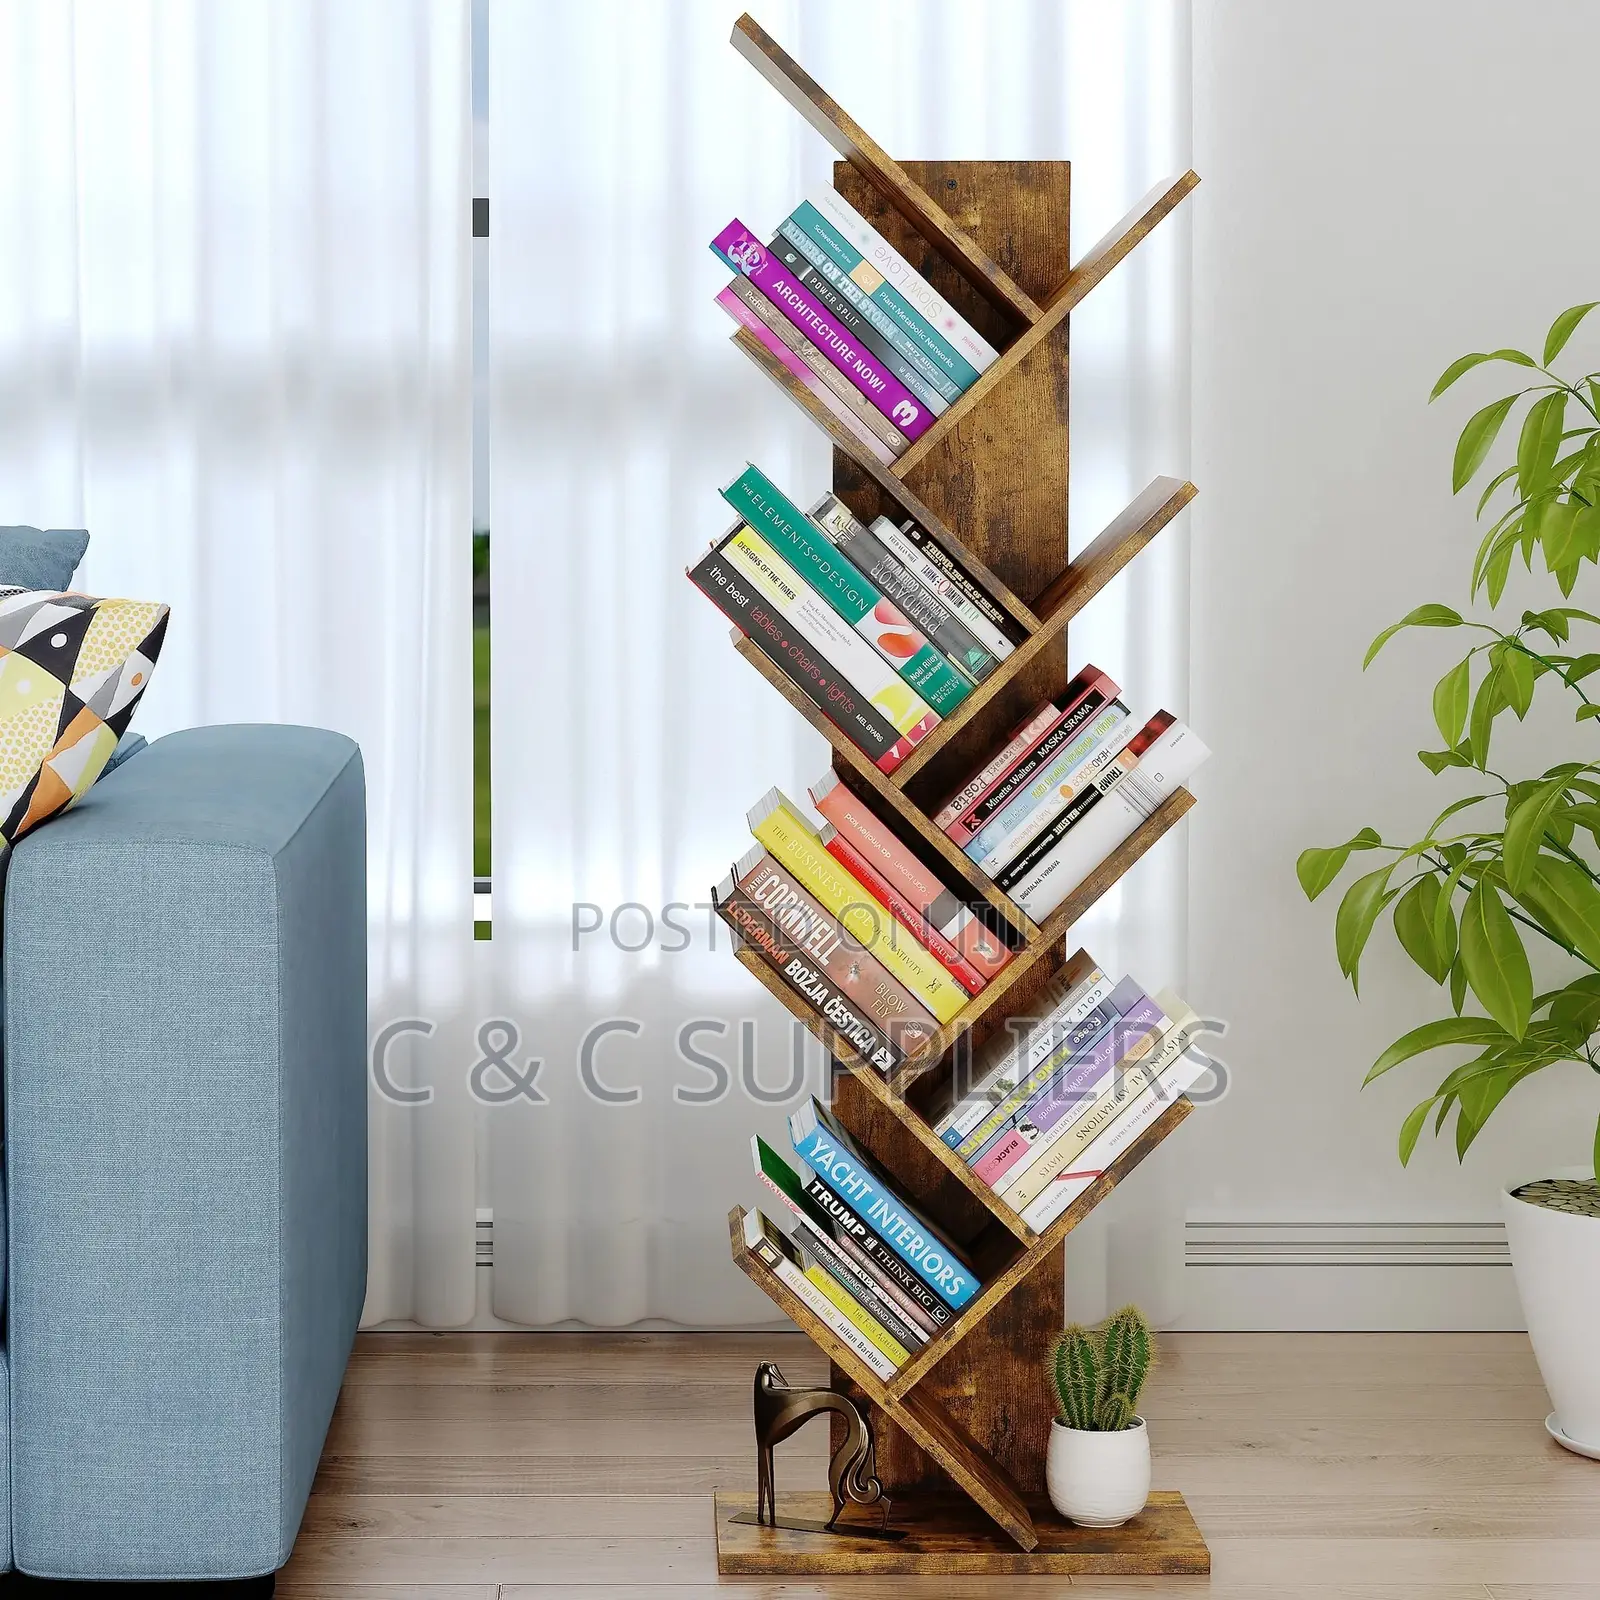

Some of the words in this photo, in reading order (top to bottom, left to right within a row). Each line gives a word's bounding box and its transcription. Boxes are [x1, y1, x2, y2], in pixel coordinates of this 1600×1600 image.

[812, 223, 843, 254] Schwender
[780, 221, 826, 267] RIDERS
[819, 259, 842, 282] ON
[834, 275, 863, 303] THE
[856, 296, 899, 339] STORM
[868, 243, 911, 286] Love
[743, 289, 773, 318] Perfume
[808, 276, 837, 305] POWER
[834, 302, 860, 327] SPLIT
[901, 276, 945, 319] Slow
[770, 277, 858, 363] ARCHITECTURE
[851, 358, 887, 394] NOW!
[878, 290, 898, 310] Plant
[893, 307, 927, 340] Metabolic
[923, 337, 956, 369] Networks
[801, 347, 827, 372] Patrick
[739, 482, 755, 497] THE
[749, 492, 815, 557] ELEMENTS
[817, 560, 870, 612] DESIGN
[735, 540, 763, 567] DESIGNS
[759, 563, 771, 575] OF
[766, 570, 779, 584] THE
[774, 579, 797, 601] TIMES
[879, 552, 921, 593] CORNWELL
[866, 559, 944, 636] PREDATOR
[919, 563, 939, 583] TAKING
[933, 576, 968, 611] QUANTUM
[950, 568, 964, 582] THE
[960, 579, 974, 593] ART
[970, 589, 982, 601] OF
[978, 597, 993, 611] THE
[989, 607, 1006, 624] DEAL
[914, 587, 951, 623] PATRICIA
[707, 564, 730, 587] the
[723, 580, 752, 608] best
[747, 602, 787, 642] tables
[785, 641, 825, 681] chairs
[821, 679, 860, 718] lights
[853, 712, 868, 727] MEL
[864, 723, 885, 743] BYARS
[921, 651, 939, 670] Riley
[915, 669, 933, 687] Patricia
[930, 673, 957, 701] MITCHELL
[935, 678, 961, 704] BEAZLEY
[983, 780, 1014, 811] Minette
[1007, 757, 1038, 787] Walters
[1035, 727, 1067, 759] MASKA
[1061, 700, 1094, 733] SRAMA
[1068, 745, 1112, 788] HEADspace
[948, 774, 989, 814] Pošta
[1095, 764, 1124, 793] TRUMP
[842, 810, 860, 828] kod
[1051, 816, 1071, 836] ESTATE
[1065, 807, 1080, 822] REAL
[854, 822, 884, 851] vincijev
[878, 846, 892, 860] da
[744, 865, 772, 893] PATRICIA
[890, 858, 915, 882] brown
[910, 877, 927, 894] dan
[770, 824, 789, 843] THE
[784, 838, 846, 899] BUSINESS
[840, 893, 875, 927] SDE
[869, 923, 883, 937] OF
[880, 934, 924, 977] CREATIVITY
[1018, 876, 1043, 900] DIGITALNA
[750, 871, 849, 968] CORNWELL
[885, 894, 901, 911] THE
[898, 907, 922, 931] FABRIC
[918, 927, 931, 940] OF
[927, 936, 955, 963] REALITY
[723, 898, 791, 966] LEDERMAN
[782, 954, 834, 1006] BOŽJA
[820, 992, 883, 1055] ČESTICA
[869, 997, 893, 1021] FLY
[873, 981, 908, 1016] BLOW
[1074, 988, 1103, 1016] GOLF
[1058, 1016, 1075, 1032] AT
[1071, 1015, 1103, 1046] Reese
[1128, 1007, 1153, 1032] Wicked
[1031, 1032, 1058, 1059] YALE
[1110, 1027, 1133, 1049] Words
[1034, 1045, 1073, 1083] HONG
[1081, 1062, 1097, 1078] Best
[1092, 1051, 1108, 1067] The
[1129, 1028, 1189, 1088] EXISTENTIAL
[1054, 1080, 1079, 1104] Wicked
[1073, 1073, 1085, 1085] of
[1001, 1078, 1039, 1116] KONG
[1036, 1099, 1059, 1121] Words
[1070, 1090, 1096, 1116] INVISIBLE
[1042, 1113, 1074, 1144] CAPITALISM
[1074, 1084, 1132, 1142] ASPIRATIONS
[958, 1110, 1006, 1158] NIGHTS
[994, 1138, 1019, 1163] BLACK
[1037, 1151, 1064, 1178] HAYES
[804, 1135, 874, 1205] YACHT
[865, 1196, 968, 1298] INTERIORS
[806, 1179, 868, 1240] TRUMP
[873, 1246, 915, 1288] THINK
[909, 1282, 935, 1307] BIG
[811, 1240, 837, 1266] STEPHEN
[833, 1262, 862, 1291] HAWKING
[857, 1289, 872, 1304] THE
[867, 1299, 890, 1322] GRAND
[885, 1317, 908, 1340] DESIGN
[812, 1226, 856, 1269] MASTER
[855, 1268, 878, 1290] KEY
[876, 1289, 920, 1332] SYSTEM
[784, 1270, 801, 1286] THE
[796, 1281, 813, 1298] END
[808, 1294, 822, 1307] OF
[817, 1303, 837, 1322] TIME
[835, 1320, 859, 1344] Julian
[855, 1340, 885, 1370] Barbour
